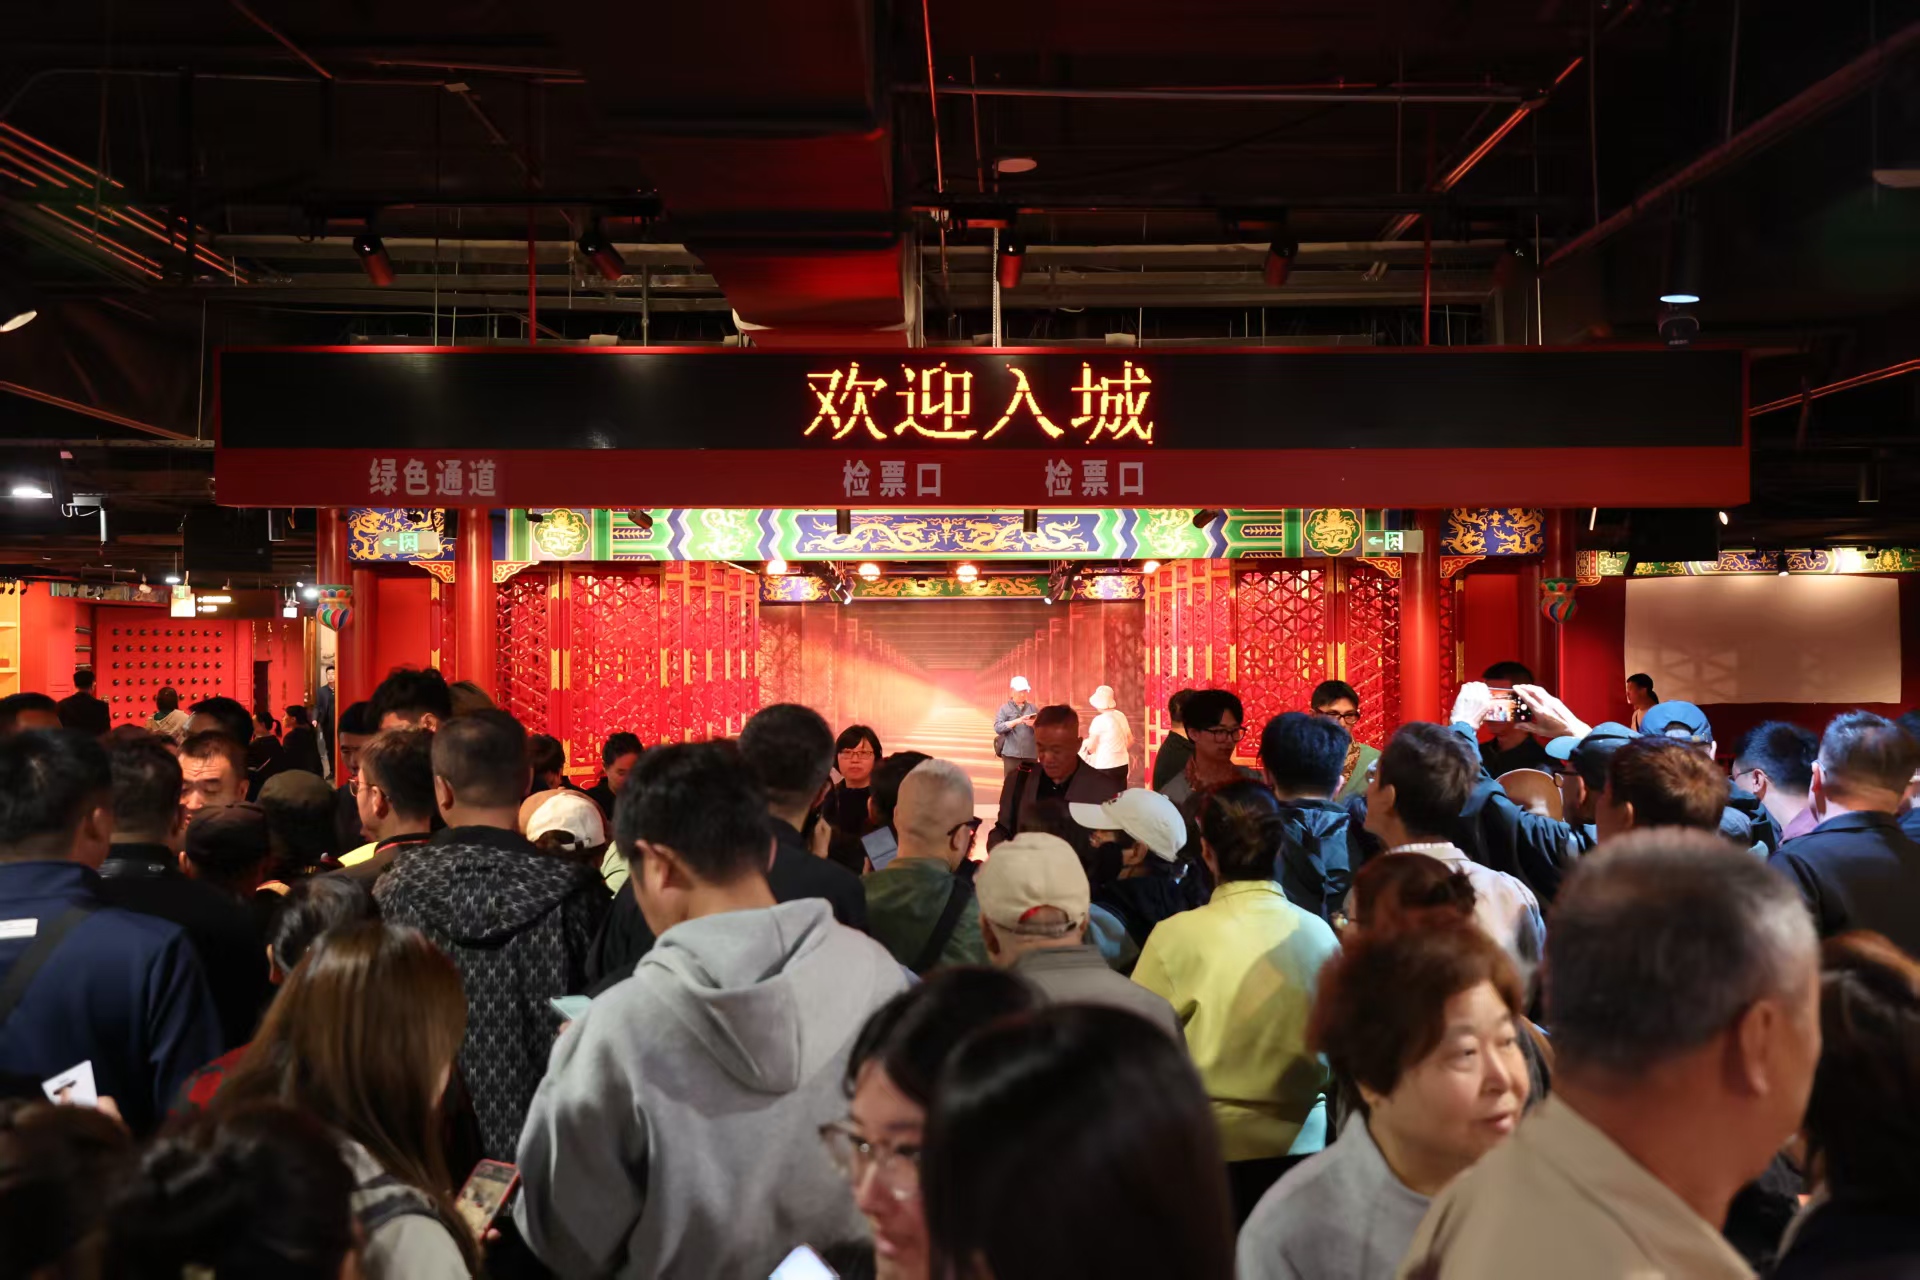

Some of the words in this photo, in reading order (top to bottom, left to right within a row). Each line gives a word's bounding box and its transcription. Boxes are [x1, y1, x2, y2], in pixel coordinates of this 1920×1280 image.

[803, 361, 1154, 444] 欢迎入城
[369, 457, 497, 497] 绿色通道
[843, 459, 941, 497] 检票口
[1045, 459, 1144, 497] 检票口
